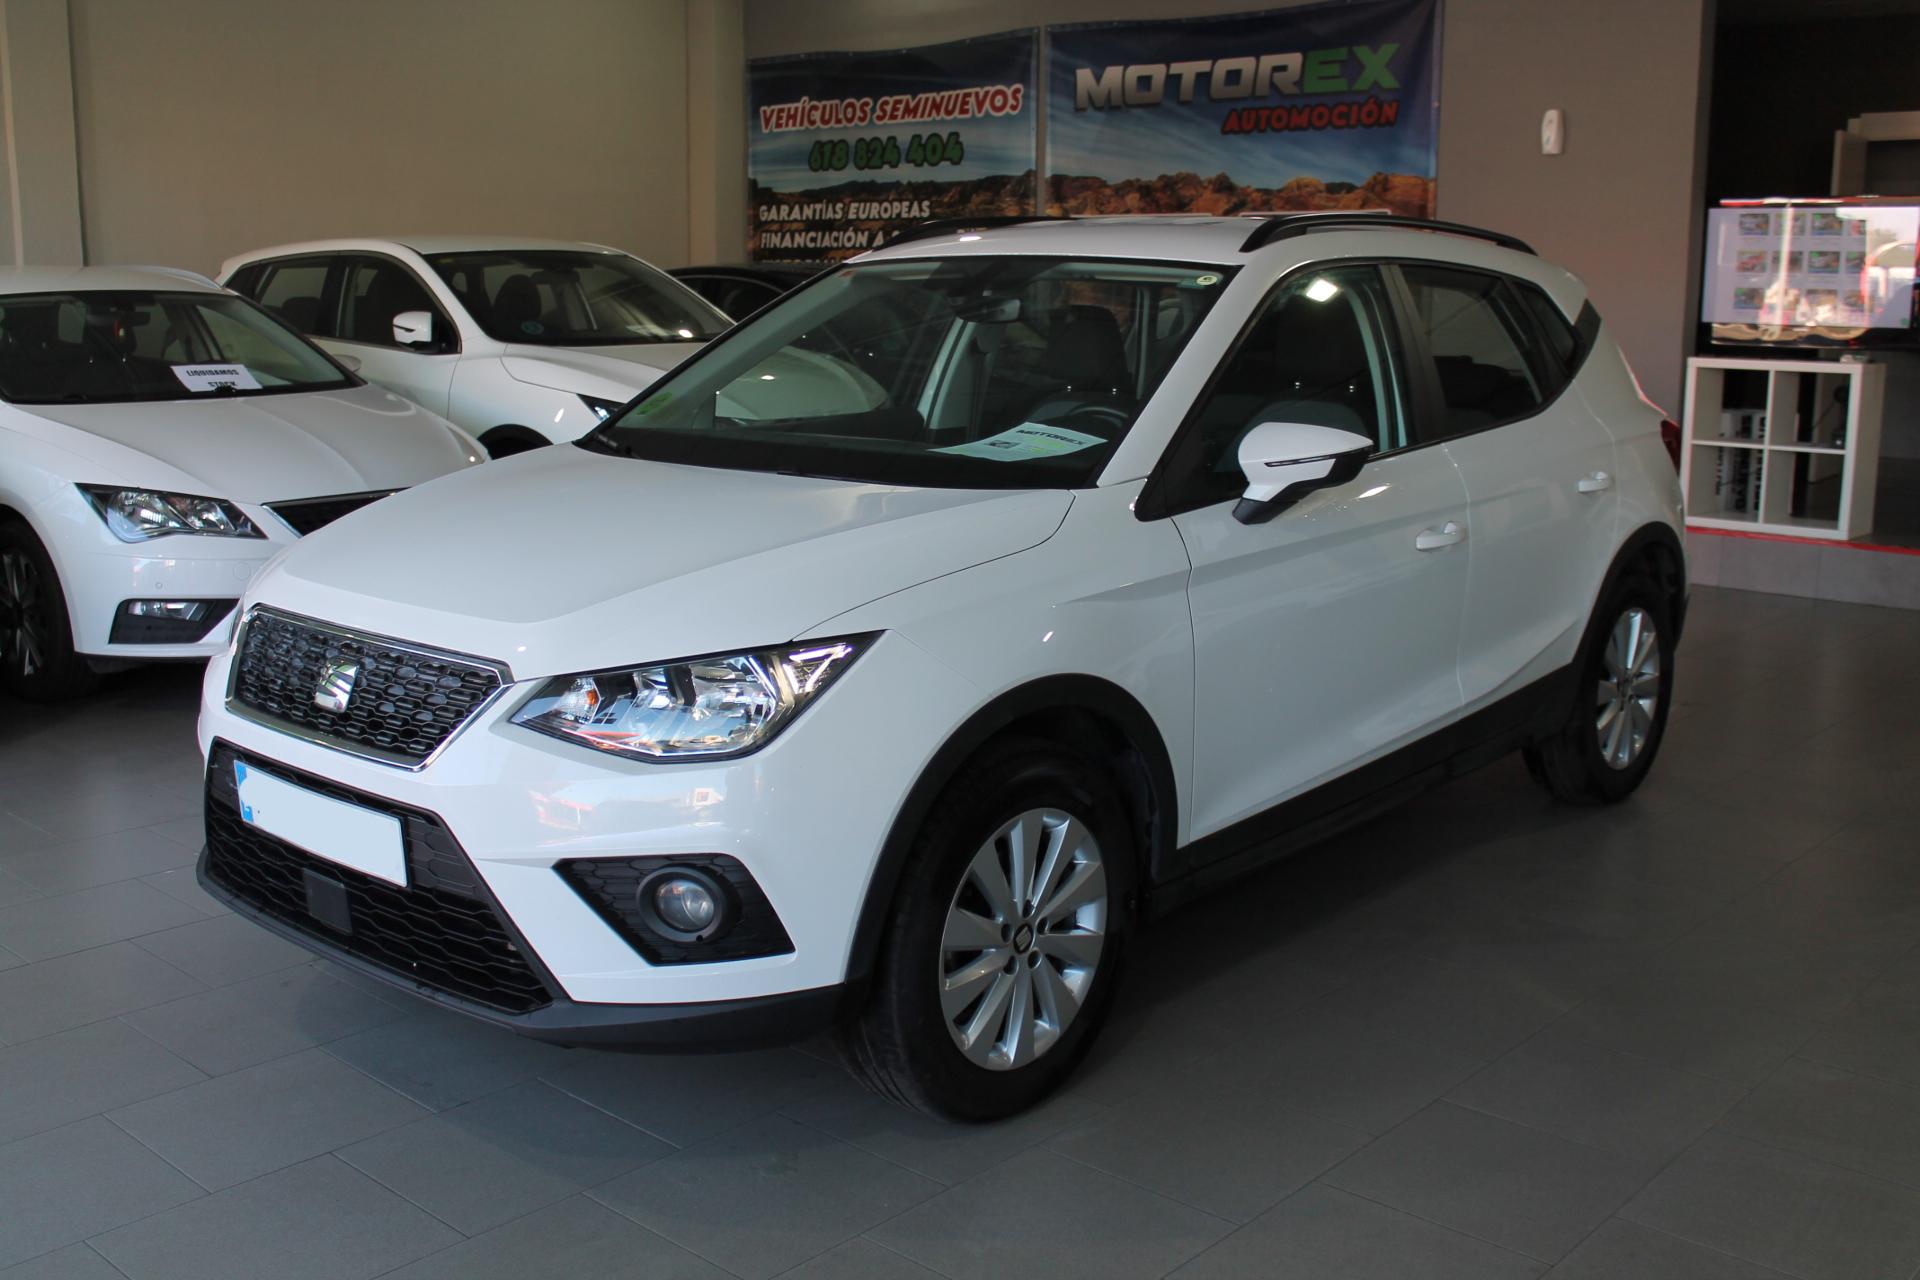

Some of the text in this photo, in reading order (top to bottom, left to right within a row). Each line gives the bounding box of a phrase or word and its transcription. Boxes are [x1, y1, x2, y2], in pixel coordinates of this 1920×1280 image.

[1075, 43, 1400, 111] MOTOREX
[761, 84, 1023, 133] VEHÍCULOS SEMINUEVOS
[1221, 98, 1399, 134] AUTOMOCIÓN
[808, 131, 965, 172] 618 824 404
[759, 200, 931, 221] GARANTÍAS EUROPEAS
[760, 227, 869, 248] FINANCIACIÓN
[872, 230, 884, 247] A
[186, 369, 239, 377] LIQUIDAMOS
[1017, 430, 1086, 445] MOTOREX
